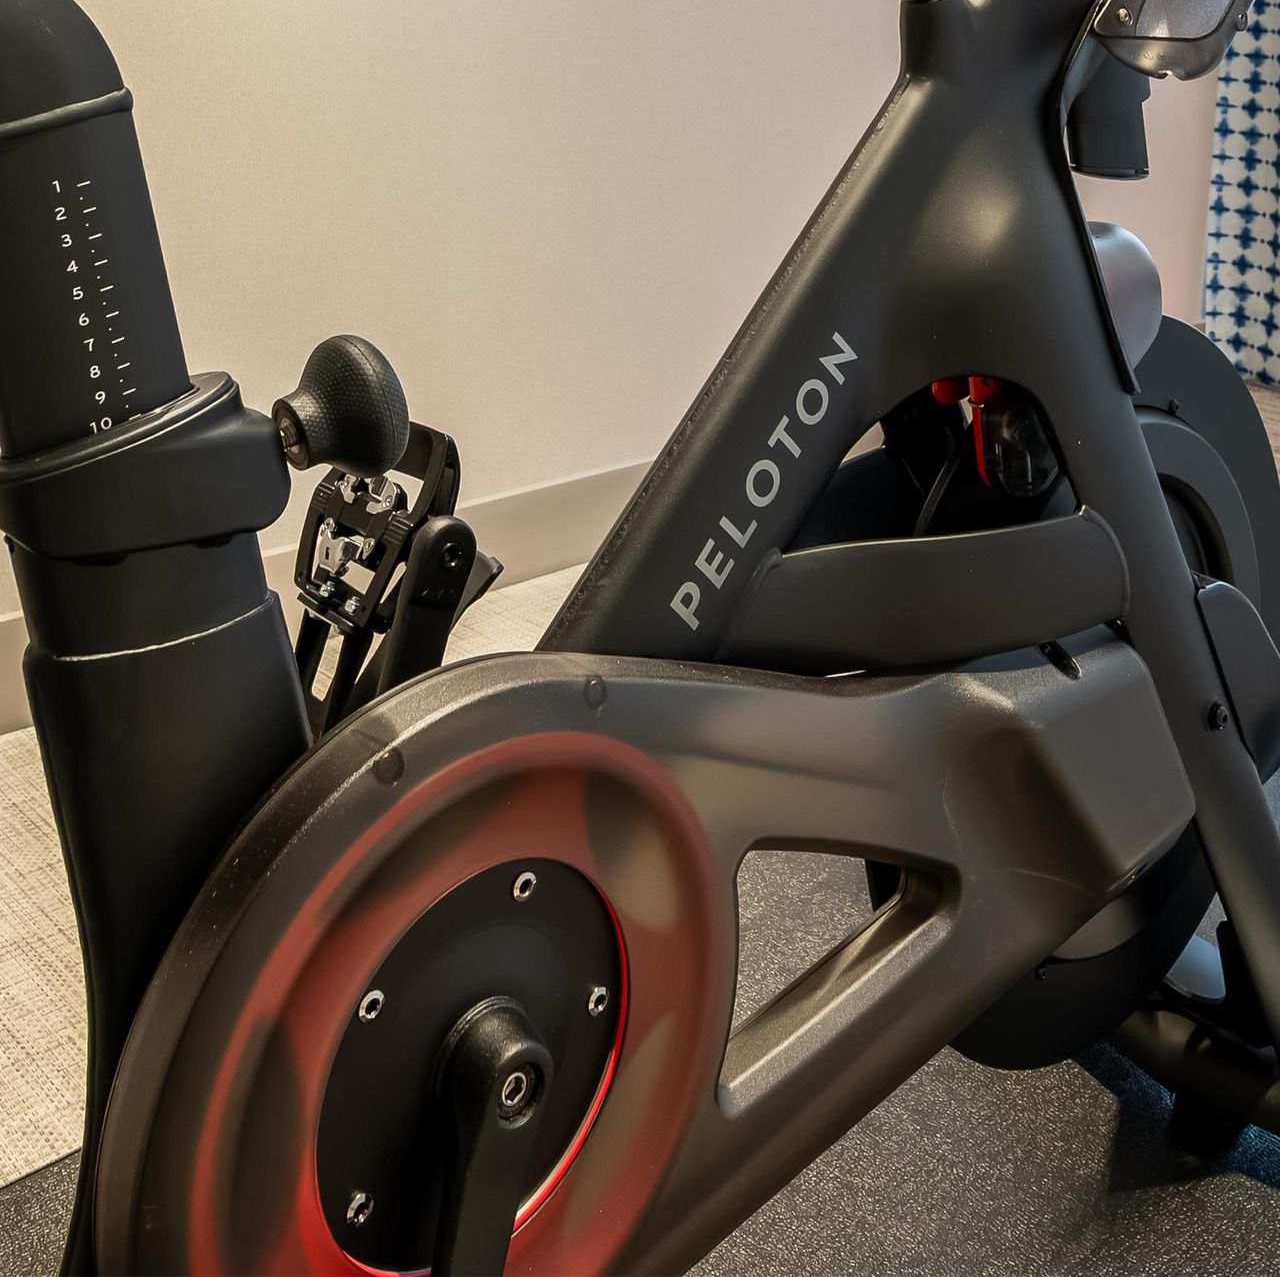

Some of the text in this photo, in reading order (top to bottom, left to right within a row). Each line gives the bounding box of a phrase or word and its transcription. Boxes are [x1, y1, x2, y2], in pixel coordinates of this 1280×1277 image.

[52, 180, 61, 193] 1
[54, 206, 67, 221] 2
[60, 234, 72, 247] 3
[66, 259, 78, 273] 4
[72, 286, 84, 300] 5
[78, 313, 90, 327] 6
[83, 338, 95, 352] 7
[90, 364, 101, 379] 8
[95, 391, 106, 404] 9
[89, 416, 112, 434] 10
[670, 331, 858, 631] PELOTON
